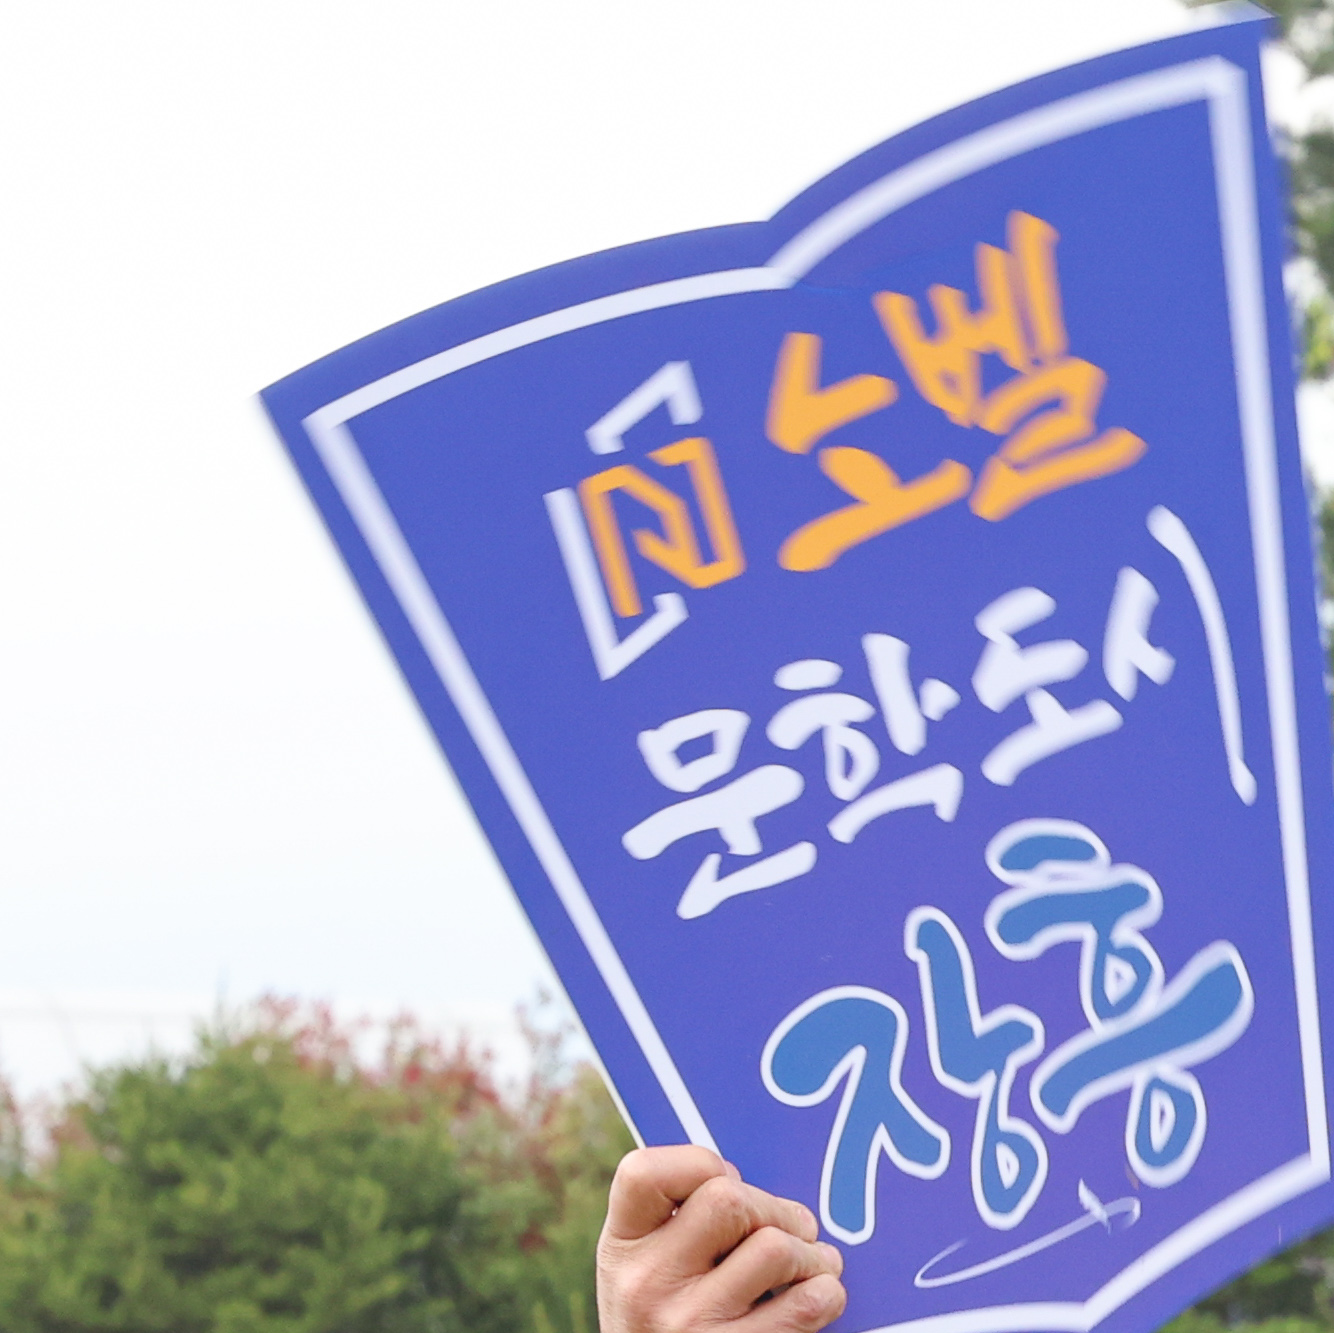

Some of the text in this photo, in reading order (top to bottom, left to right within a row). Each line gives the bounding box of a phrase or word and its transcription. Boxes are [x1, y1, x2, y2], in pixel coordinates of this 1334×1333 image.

[765, 209, 1147, 574] 노벨
[621, 503, 1258, 921] 문학도시
[760, 817, 1256, 1246] 장흥
